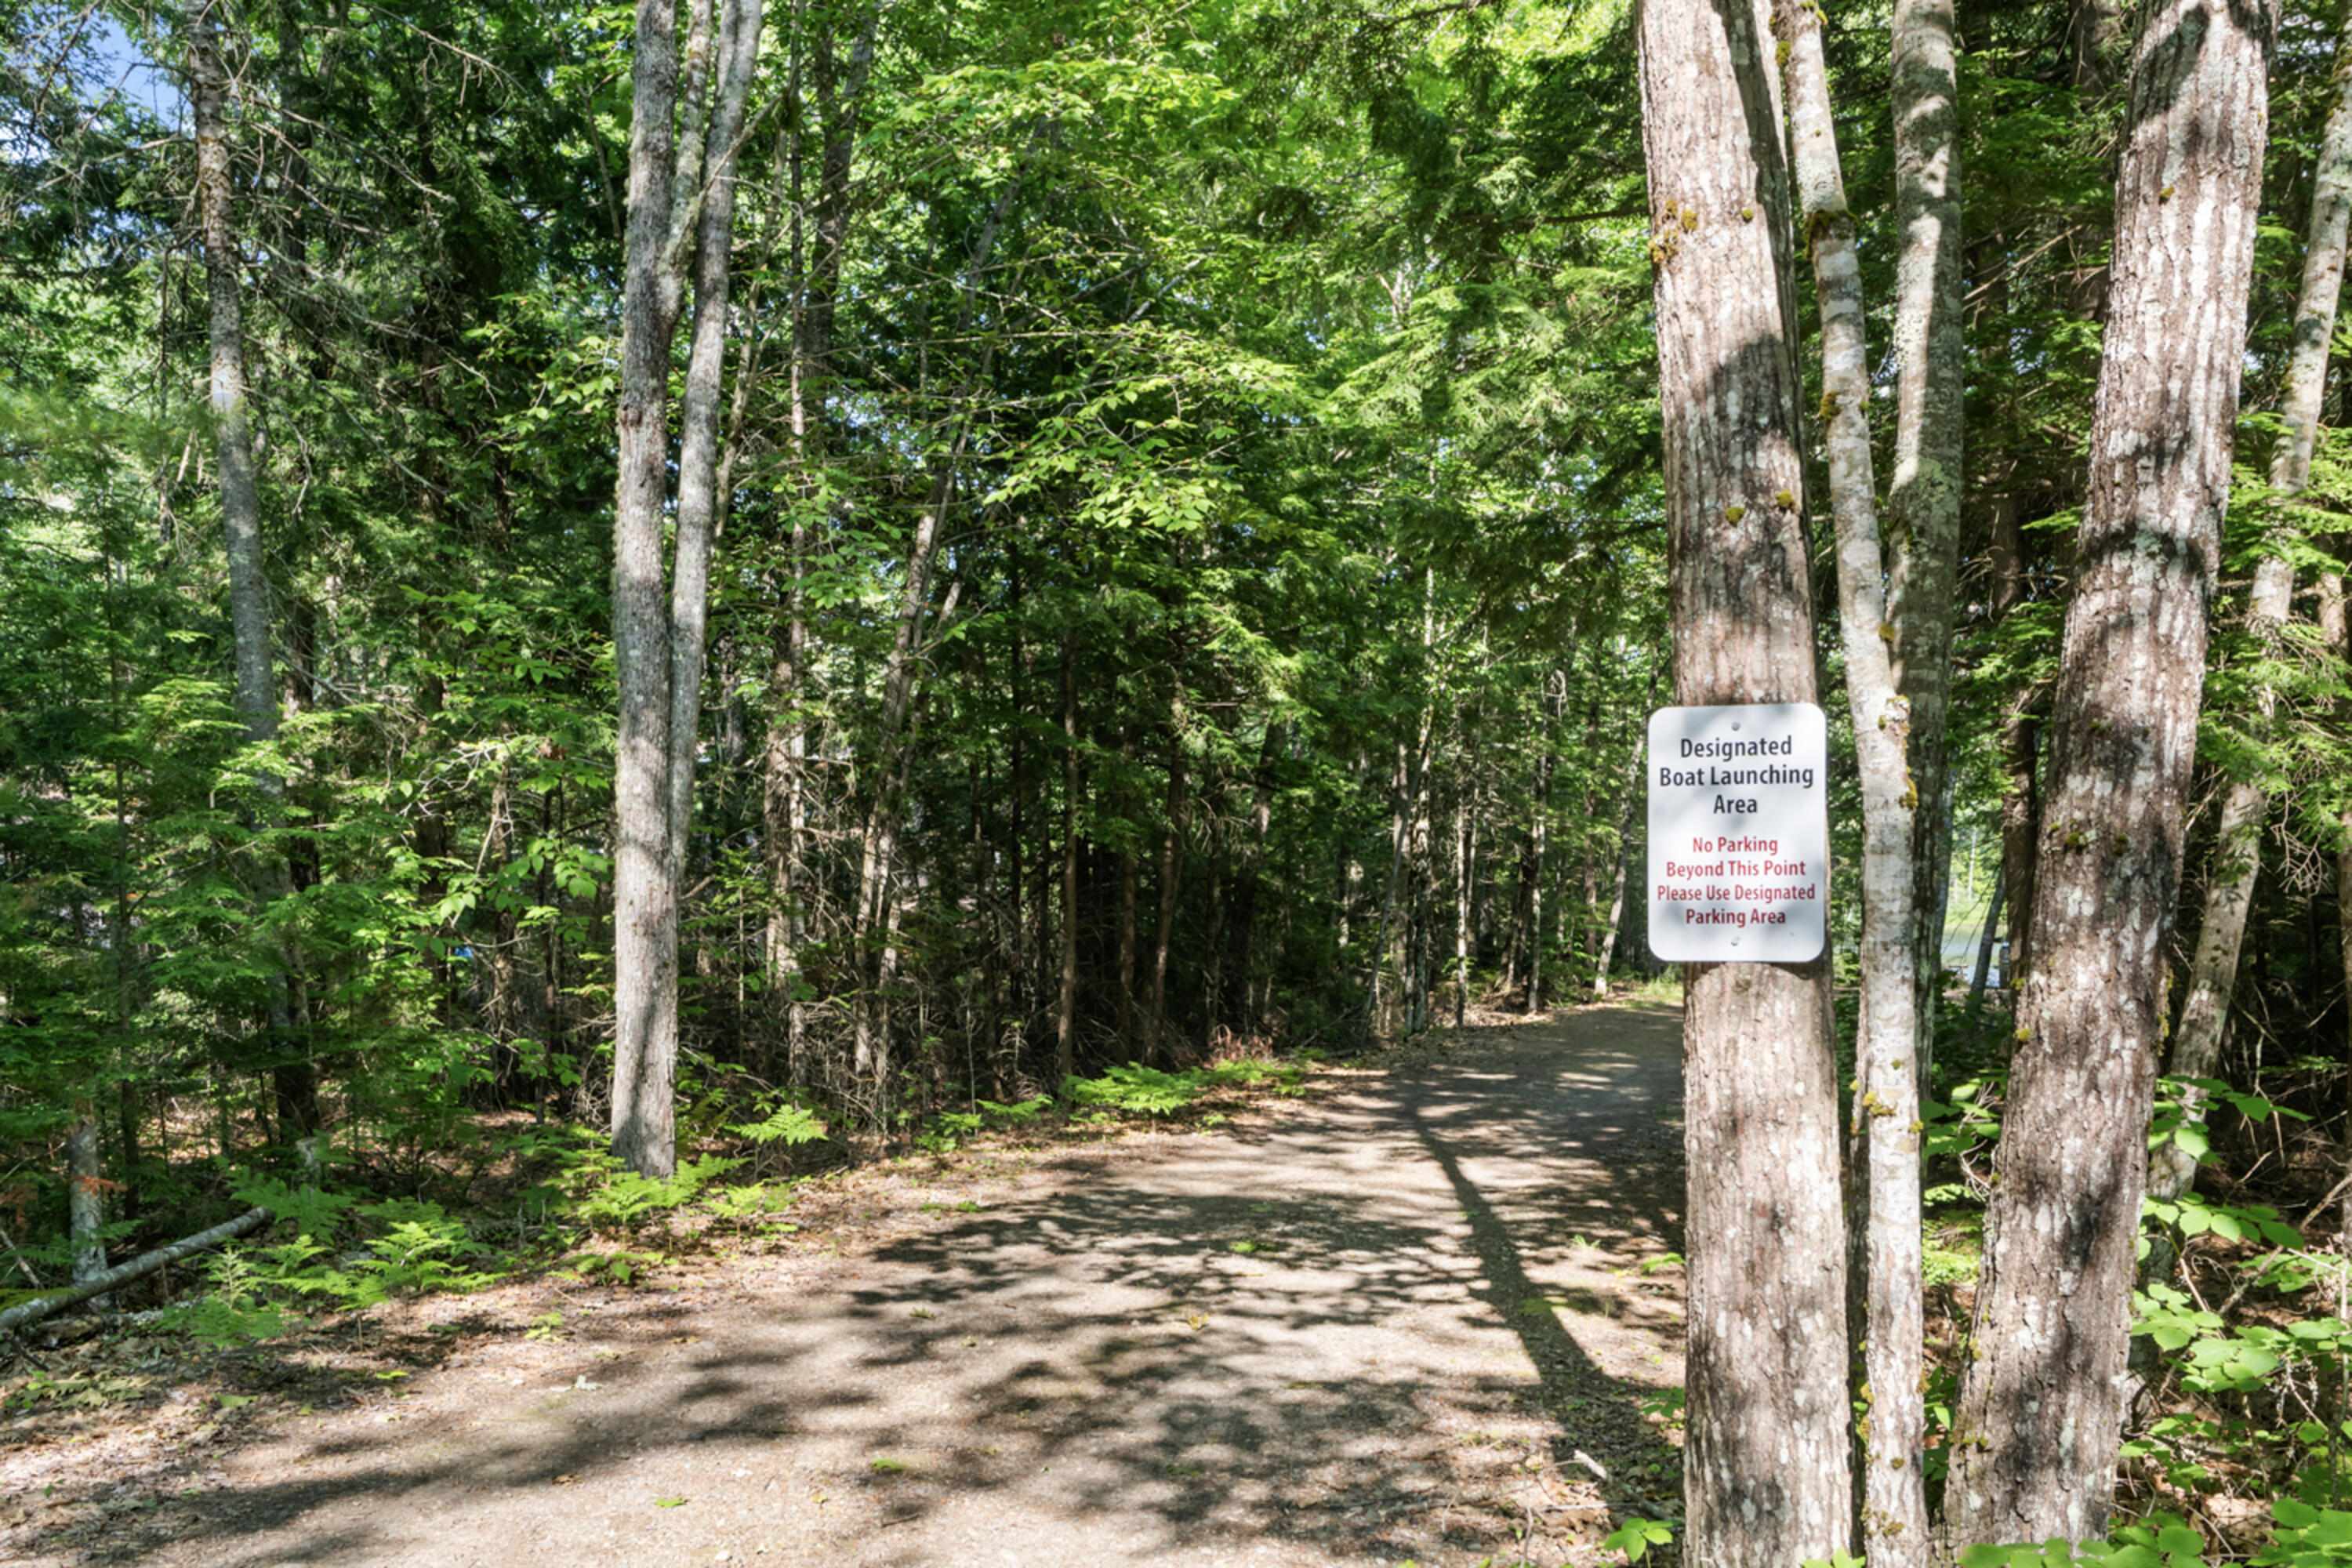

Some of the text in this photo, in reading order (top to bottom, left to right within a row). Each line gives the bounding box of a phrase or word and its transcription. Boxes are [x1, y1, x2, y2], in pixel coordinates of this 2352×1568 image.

[1680, 735, 1791, 762] Designated
[1661, 764, 1813, 789] Boat Launching
[1713, 794, 1757, 814] Area
[1693, 836, 1778, 855] No Parking
[1667, 860, 1806, 880] Beyond This Point
[1657, 884, 1815, 904] Please Use Designated
[1686, 908, 1786, 928] Parking Area
